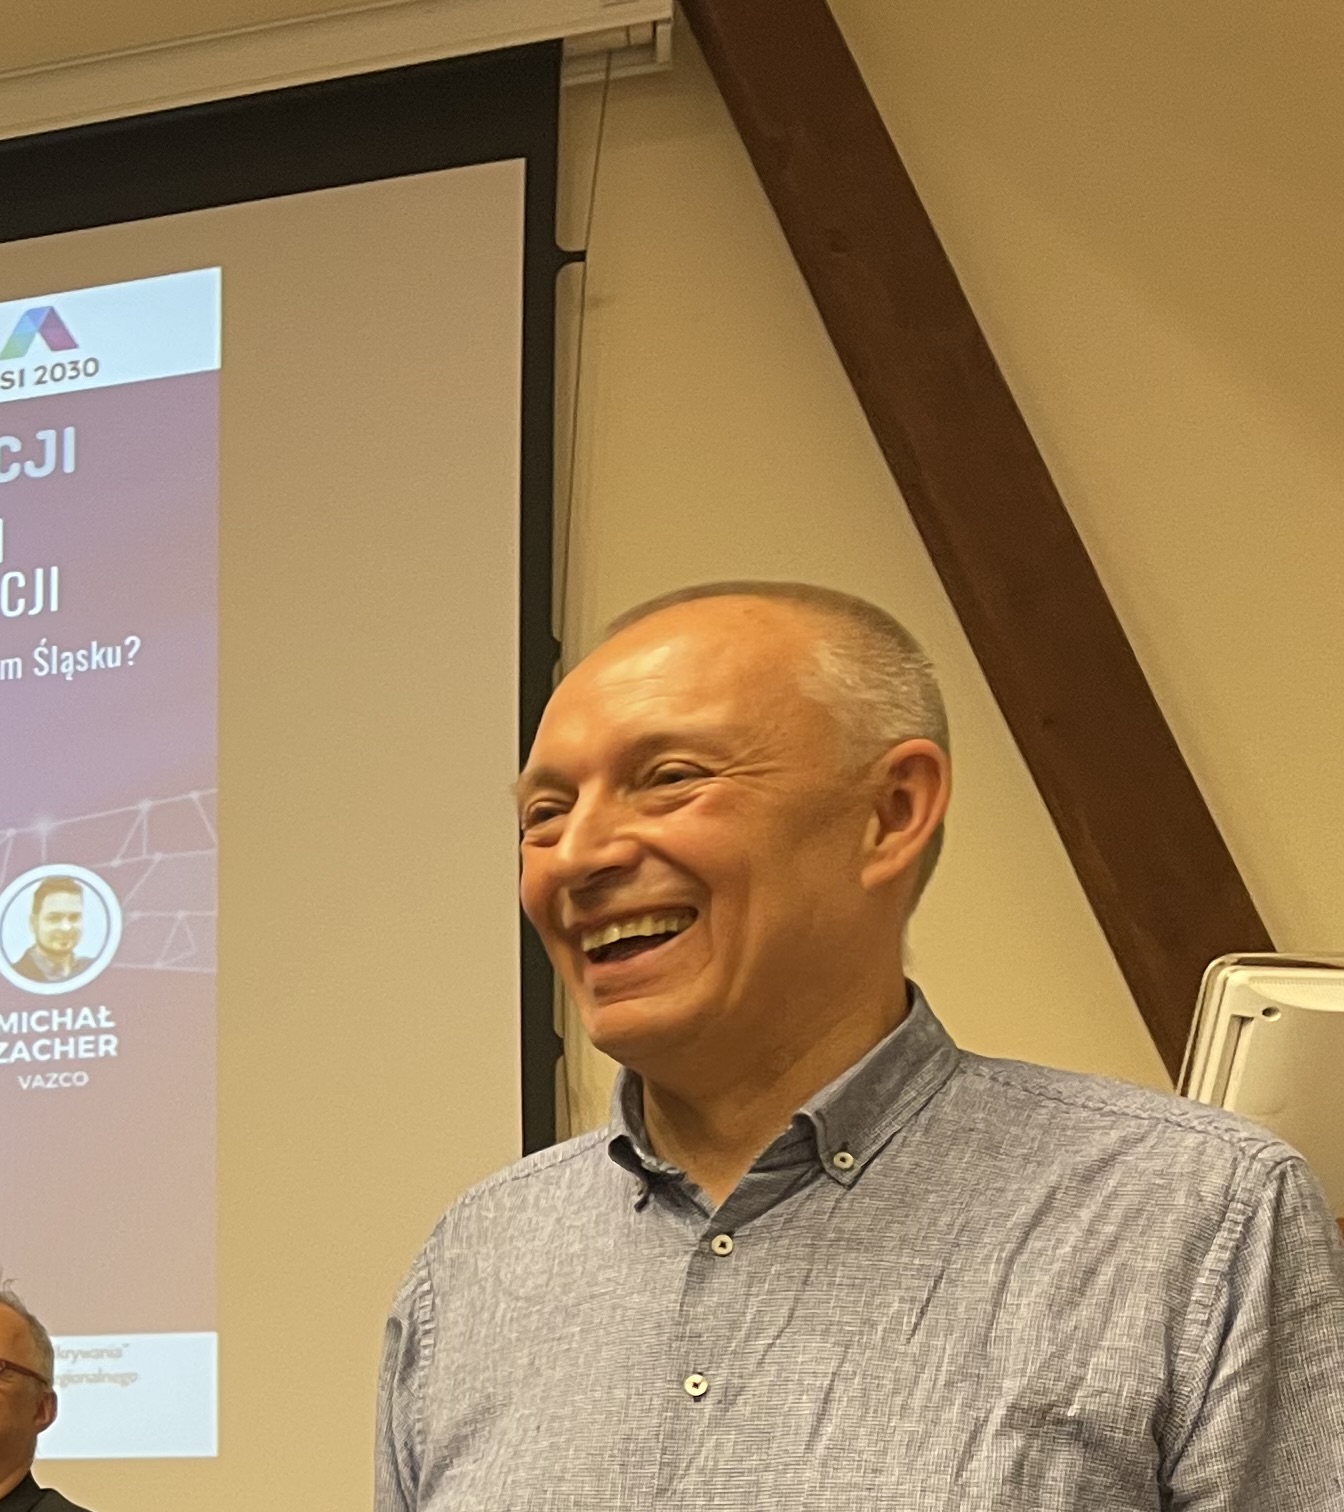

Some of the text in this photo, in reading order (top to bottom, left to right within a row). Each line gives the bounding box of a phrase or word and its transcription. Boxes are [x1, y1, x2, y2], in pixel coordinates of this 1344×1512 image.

[34, 357, 99, 386] 2030
[32, 635, 141, 680] Śląsku?
[18, 1071, 89, 1089] VAZCO
